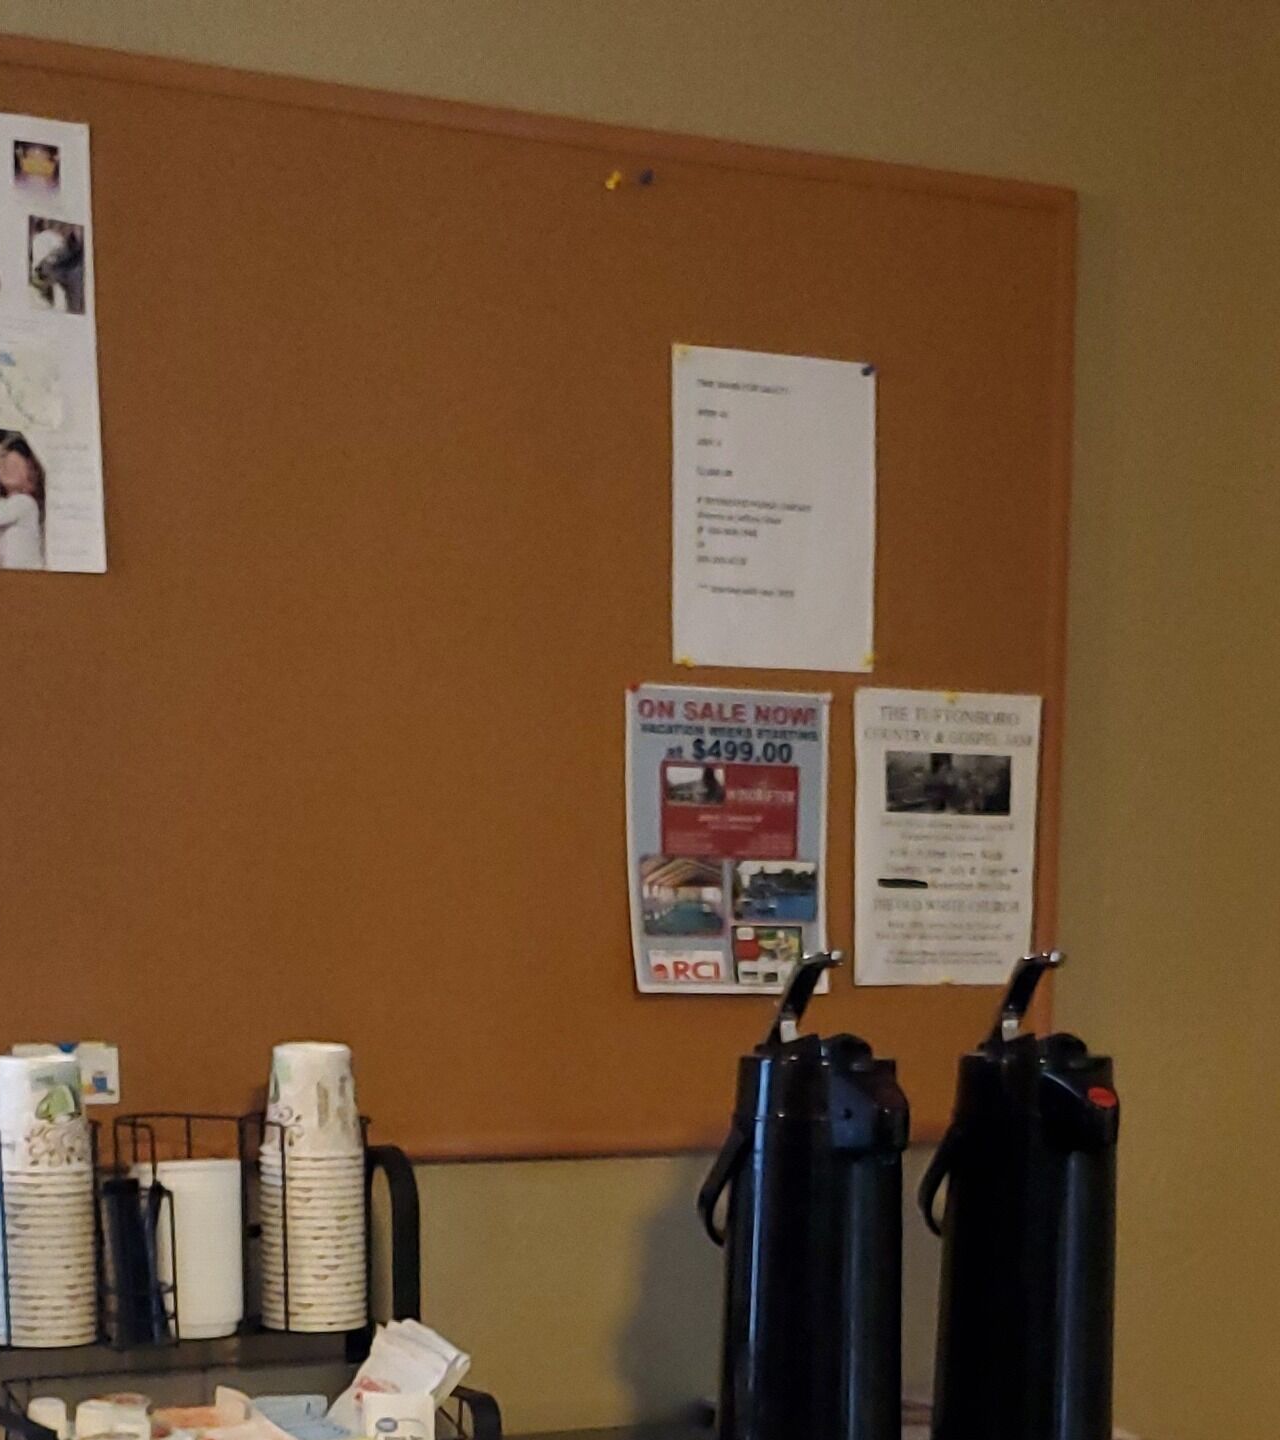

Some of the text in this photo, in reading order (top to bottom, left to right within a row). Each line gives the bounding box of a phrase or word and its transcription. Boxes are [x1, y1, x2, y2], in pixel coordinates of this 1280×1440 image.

[638, 699, 675, 719] ON
[683, 701, 747, 723] SALE
[692, 738, 793, 764] $499.00
[672, 960, 721, 980] RCI
